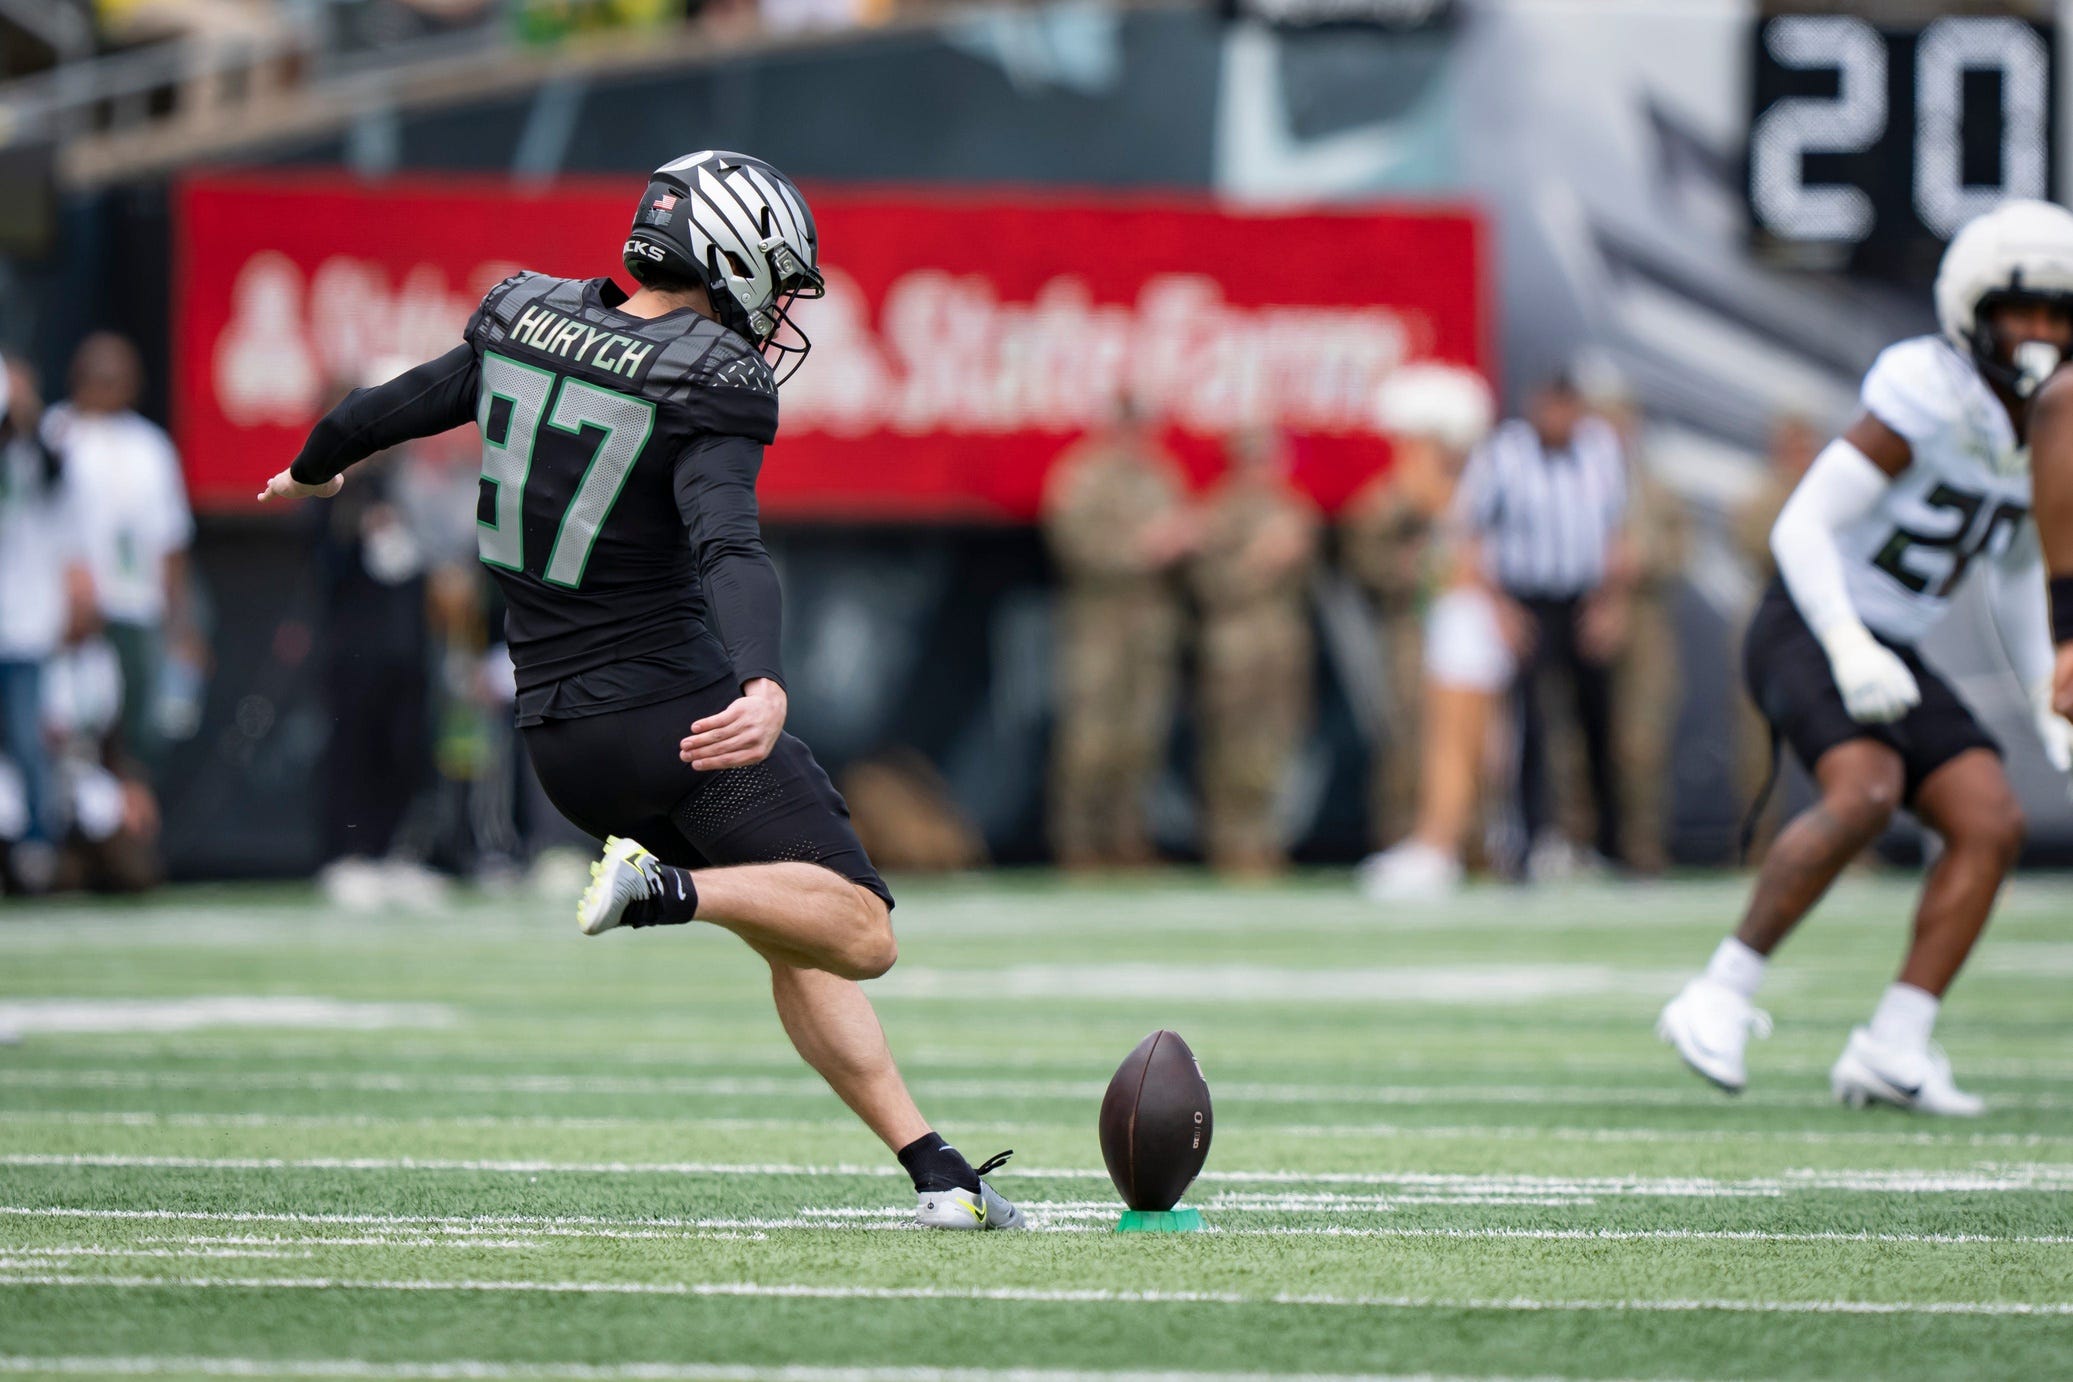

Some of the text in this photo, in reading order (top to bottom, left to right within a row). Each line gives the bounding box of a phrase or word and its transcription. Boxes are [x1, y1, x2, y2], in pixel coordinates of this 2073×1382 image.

[1752, 14, 2049, 242] 20
[623, 240, 666, 262] CKS
[509, 305, 654, 379] HURYCH
[477, 350, 656, 590] 97
